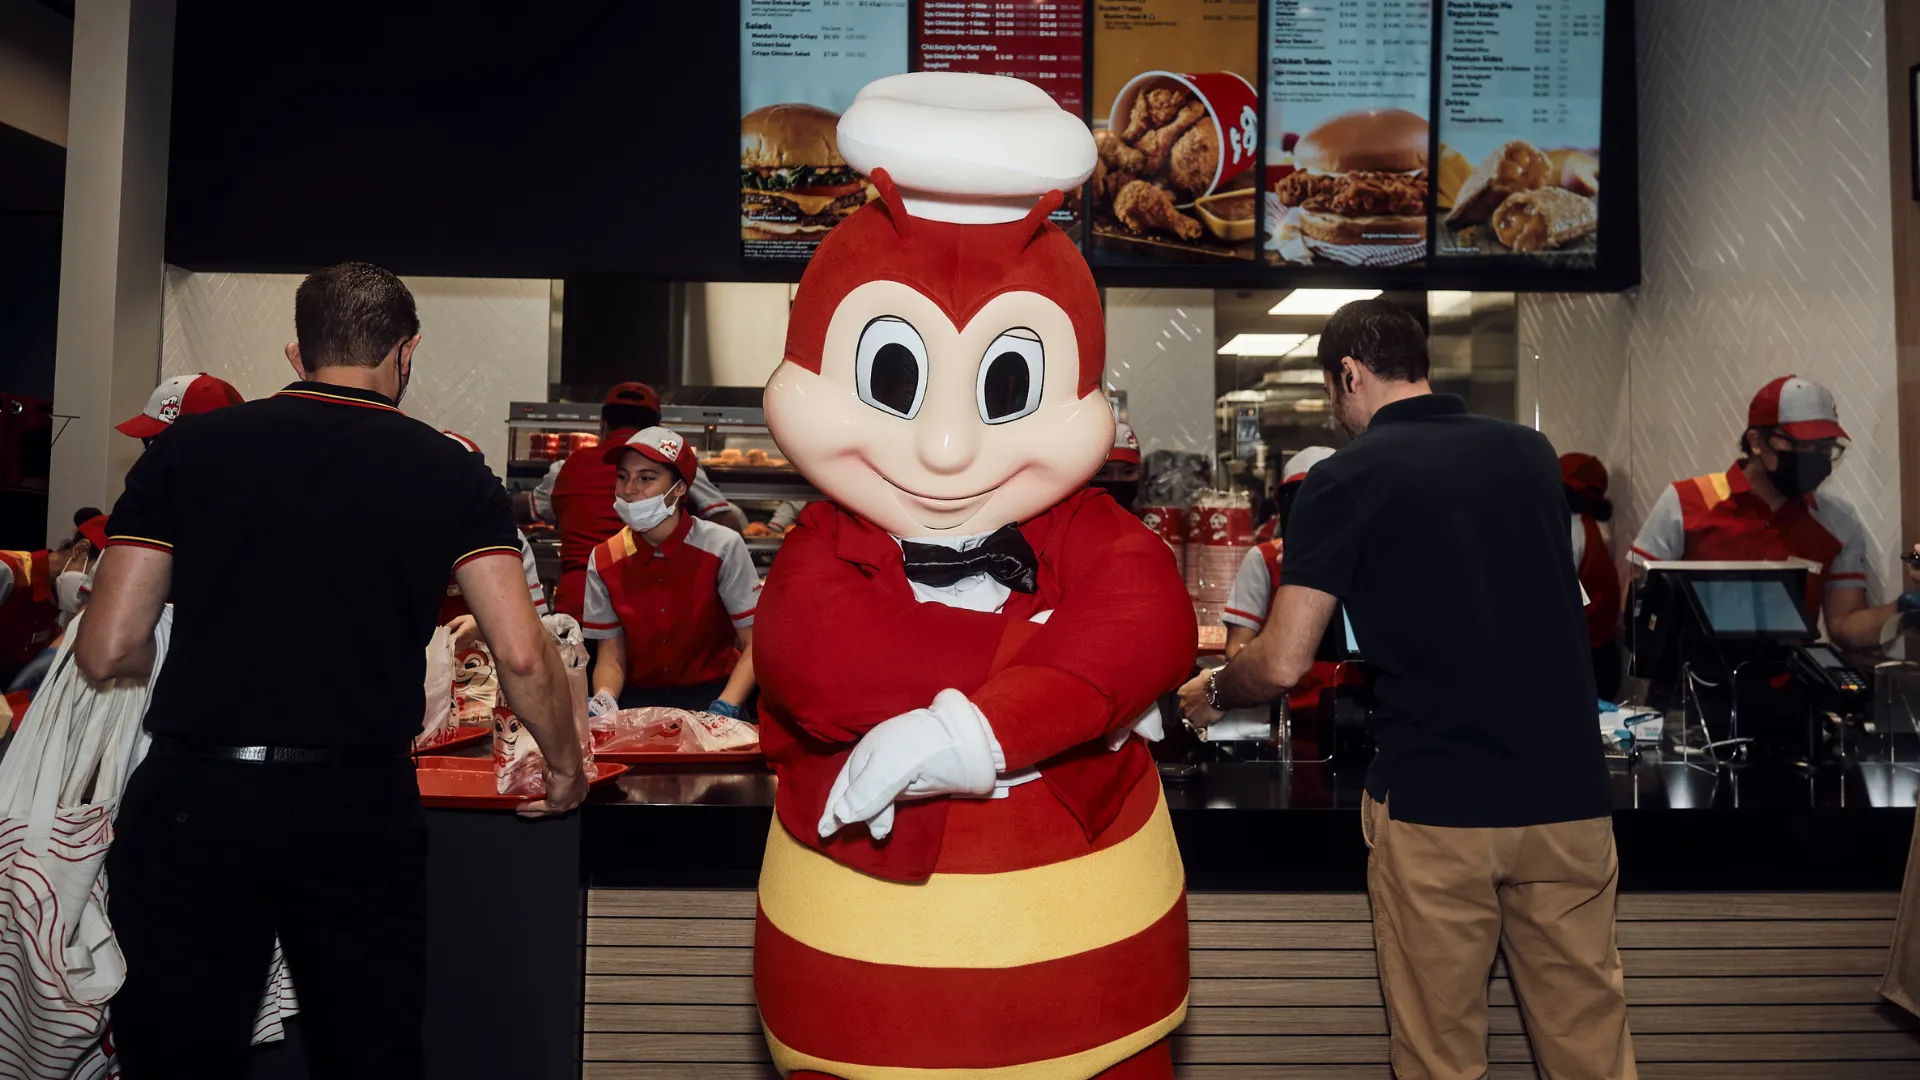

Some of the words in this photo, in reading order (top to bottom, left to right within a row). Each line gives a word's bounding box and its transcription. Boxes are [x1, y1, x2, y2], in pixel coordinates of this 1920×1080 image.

[1473, 2, 1499, 10] Mango
[745, 22, 772, 30] Salads
[1272, 57, 1302, 65] Chicken
